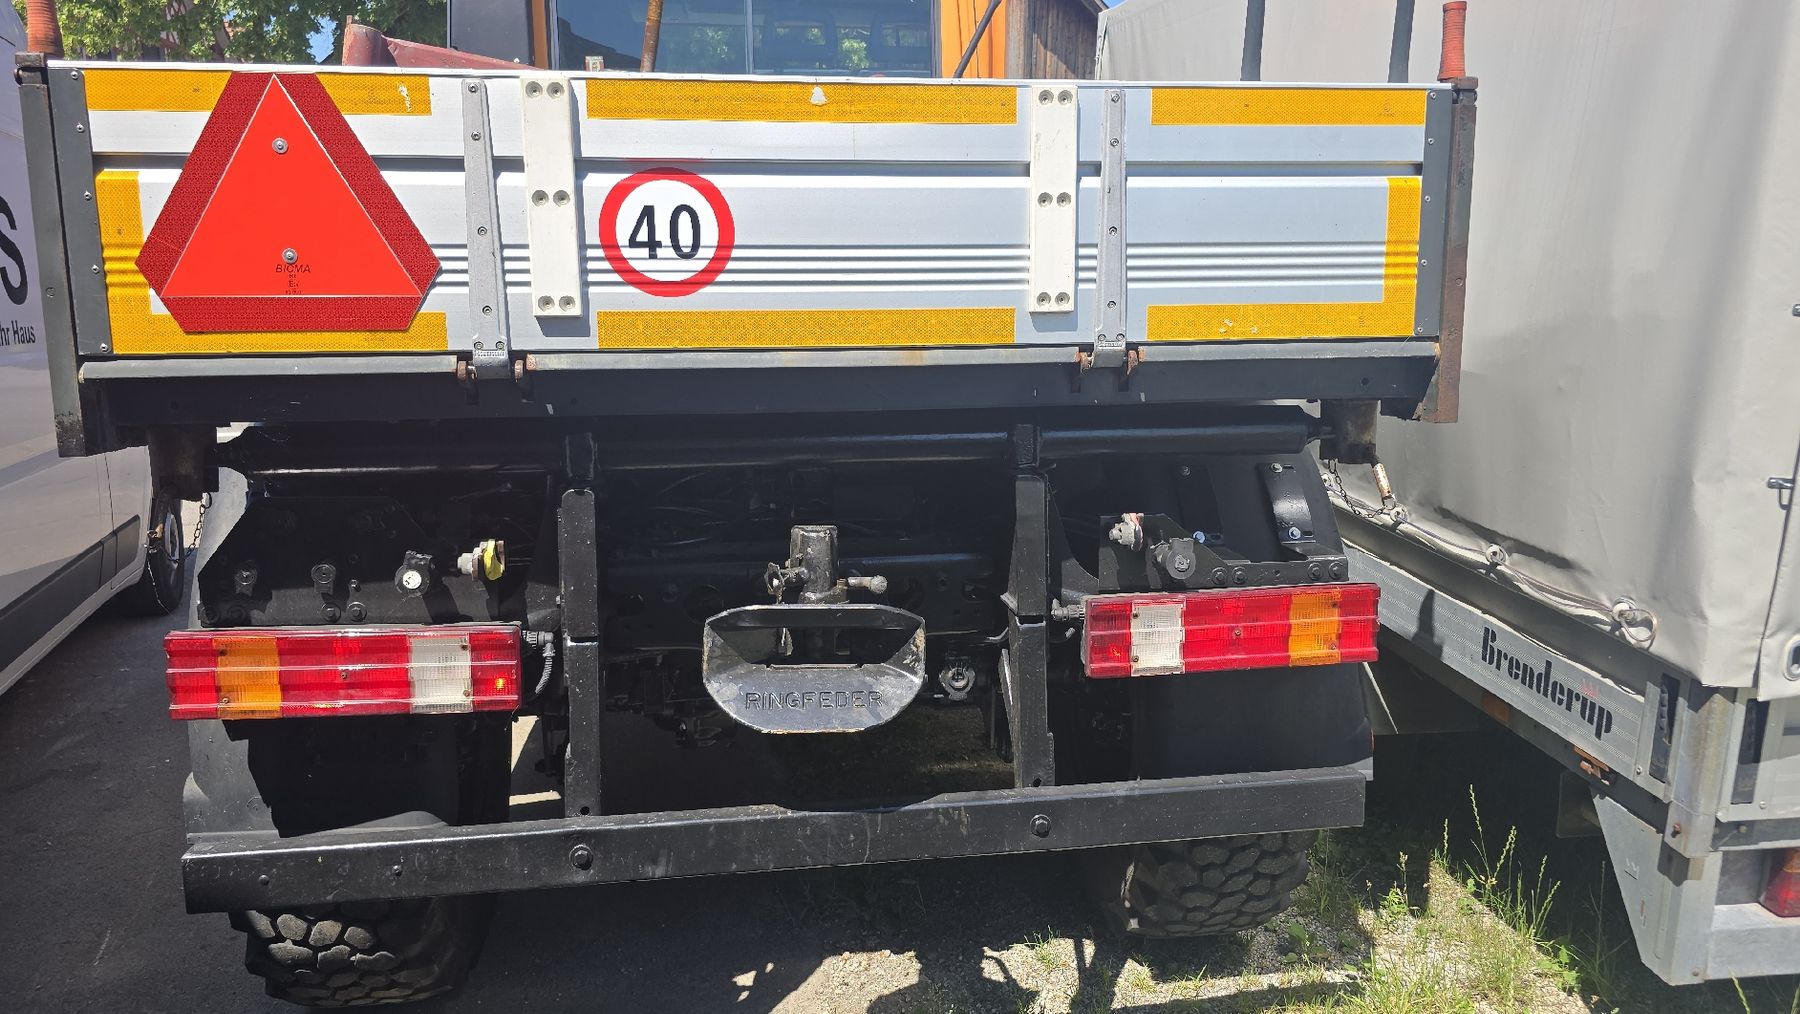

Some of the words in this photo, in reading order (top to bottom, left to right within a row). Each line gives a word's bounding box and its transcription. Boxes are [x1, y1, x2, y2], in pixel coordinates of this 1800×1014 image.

[628, 204, 701, 260] 40
[0, 321, 10, 347] hr
[11, 320, 36, 345] Haus
[745, 690, 883, 711] RINGFEDER
[1481, 626, 1613, 741] Brenderup
